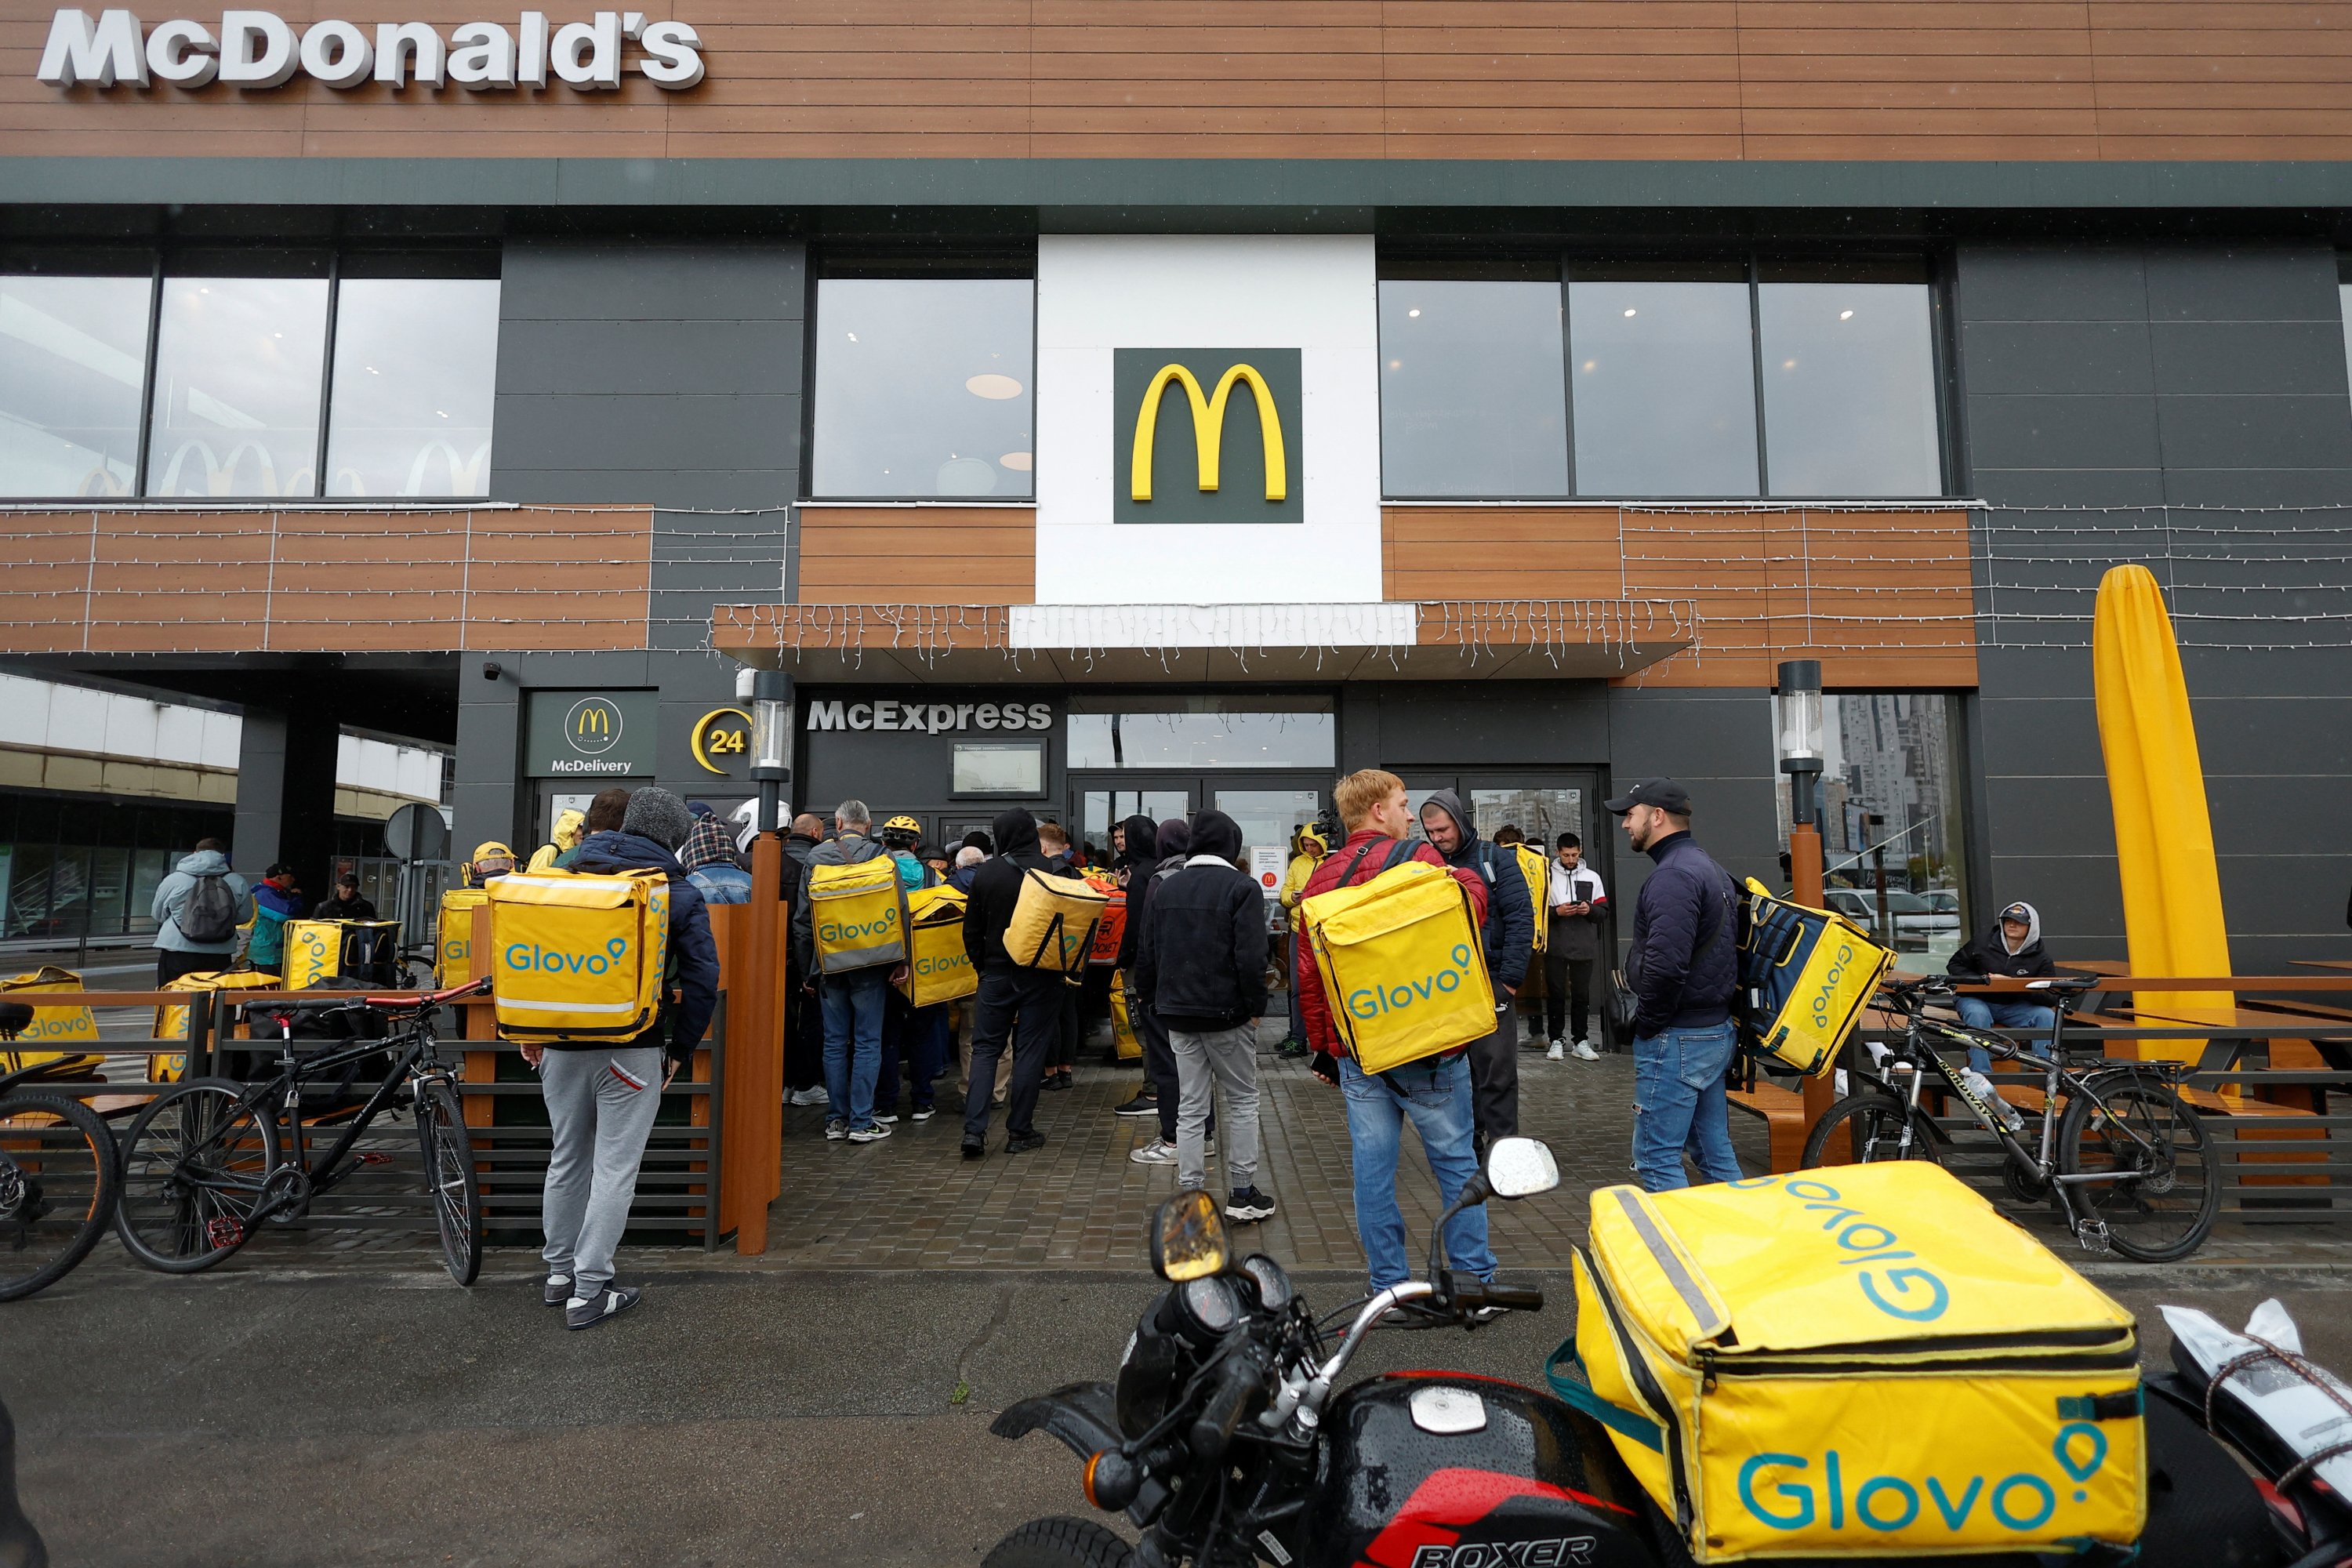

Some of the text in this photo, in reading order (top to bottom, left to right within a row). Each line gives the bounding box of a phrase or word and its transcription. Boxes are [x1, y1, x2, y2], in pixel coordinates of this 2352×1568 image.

[38, 9, 703, 89] McDonald's
[807, 700, 1053, 735] McExpress
[710, 729, 746, 754] 24
[551, 759, 632, 775] McDelivery
[819, 920, 888, 942] Glovo
[1091, 942, 1118, 953] OCKET
[505, 942, 609, 975] Glovo
[1348, 967, 1460, 1020] Glovo
[1813, 944, 1853, 1013] Glovo
[1937, 1060, 1992, 1116] NORDWAY
[1785, 1180, 1949, 1323] Glovo
[1738, 1450, 2055, 1531] Glovo
[1410, 1535, 1596, 1568] BOXER
